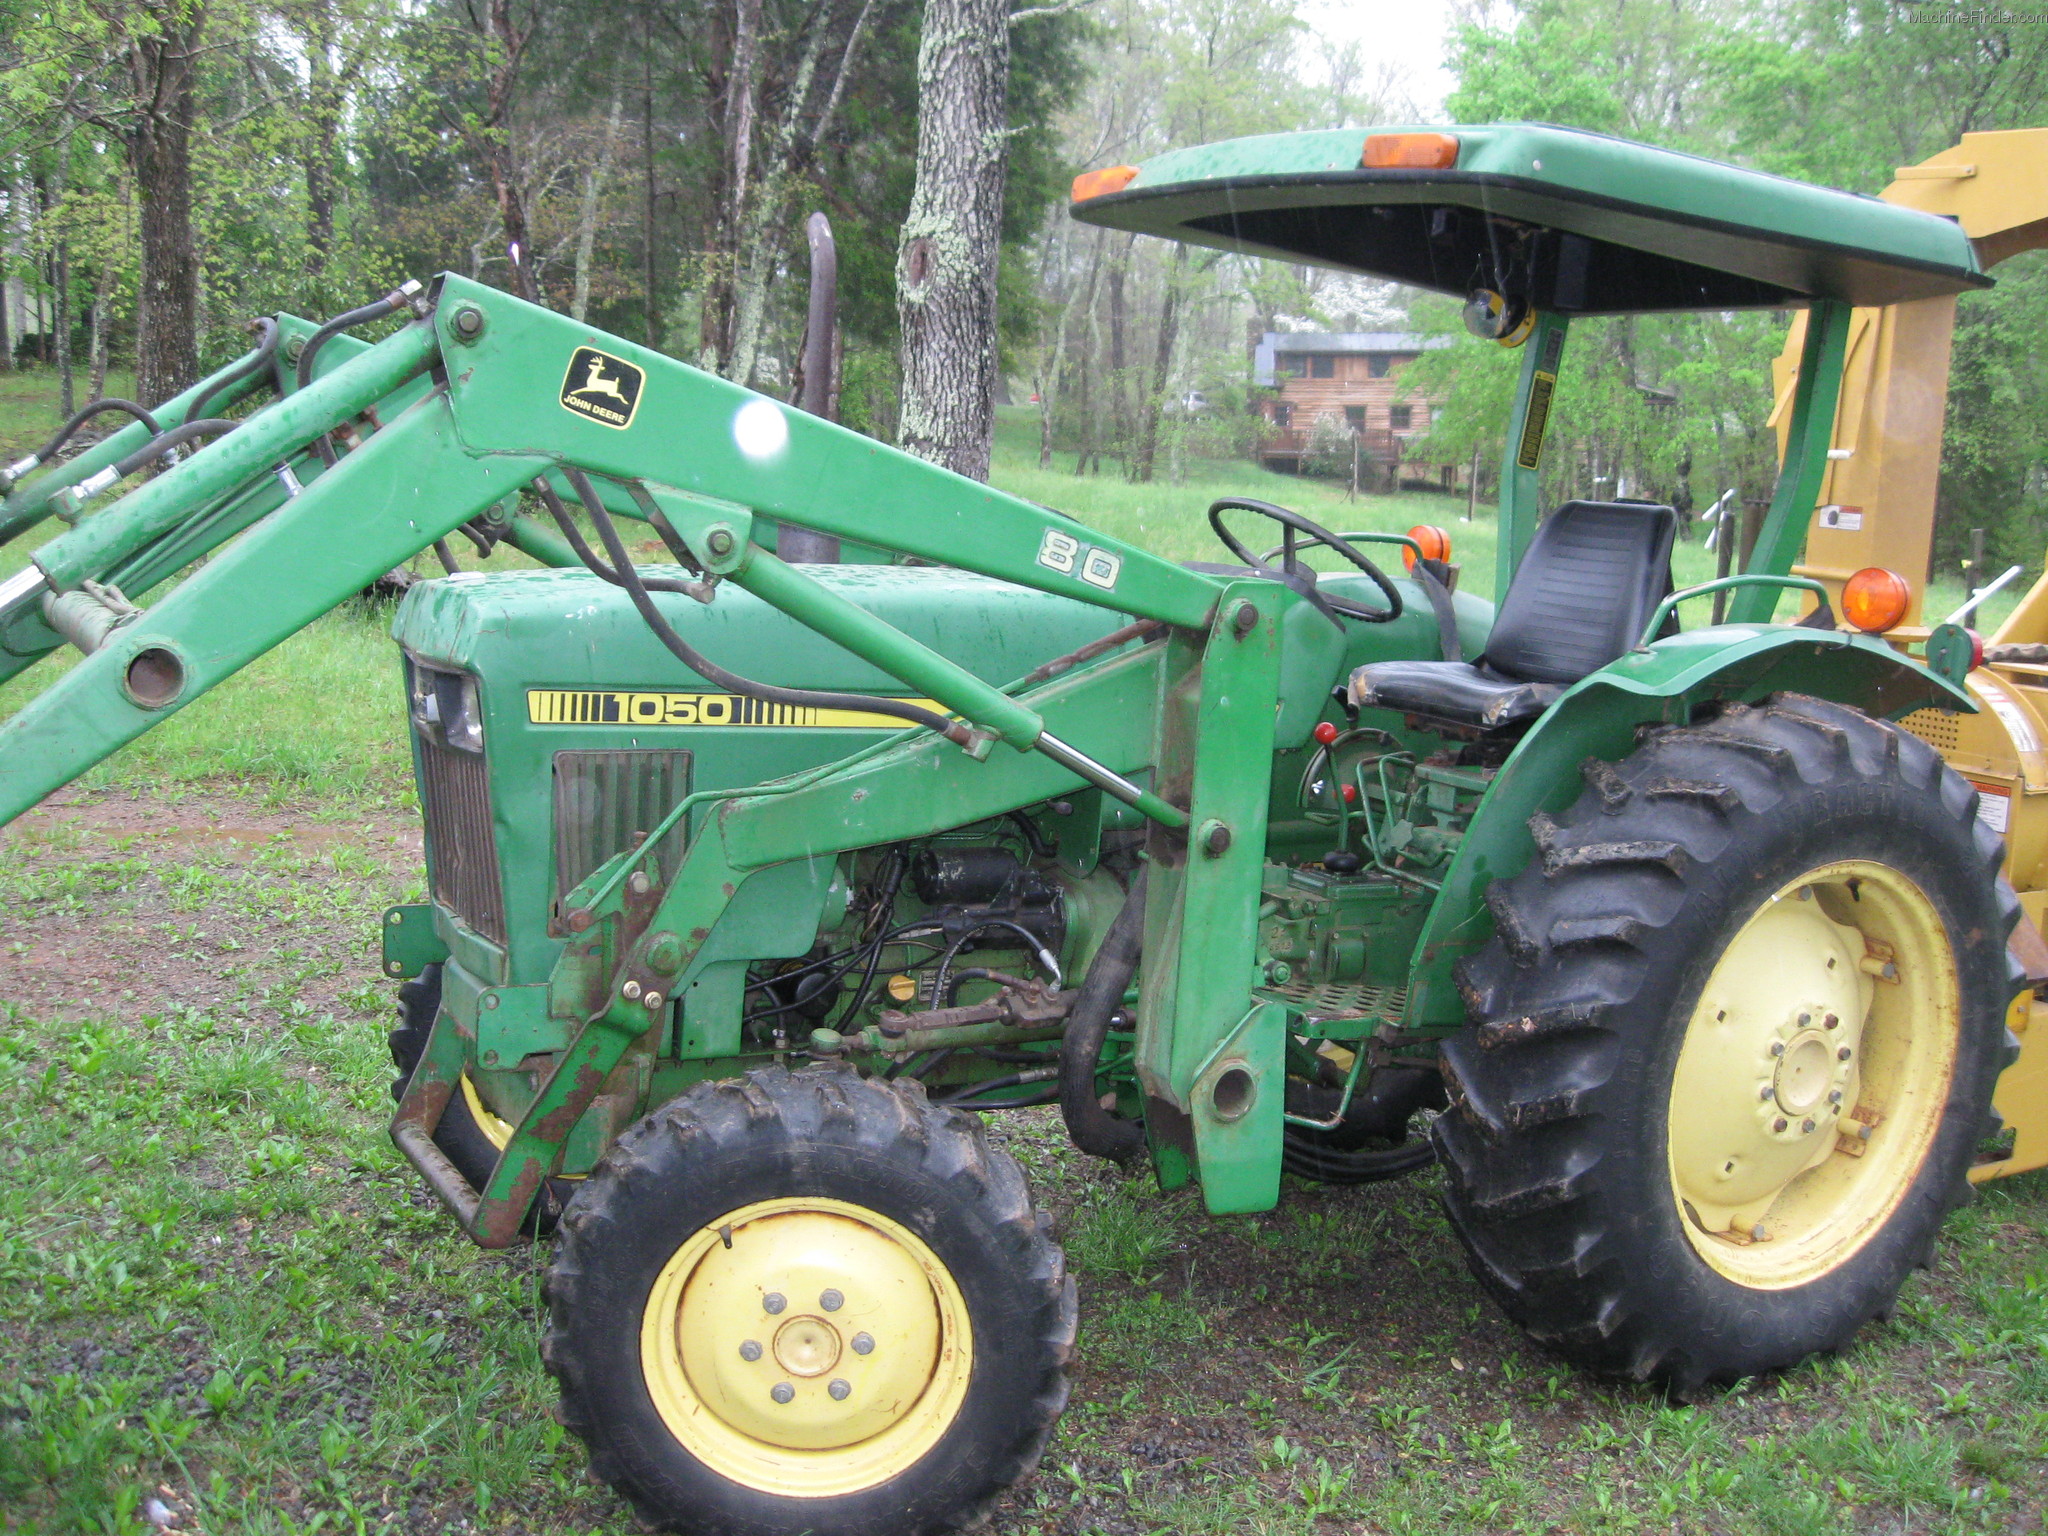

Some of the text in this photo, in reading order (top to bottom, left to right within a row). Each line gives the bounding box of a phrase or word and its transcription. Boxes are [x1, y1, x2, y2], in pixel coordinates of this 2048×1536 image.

[563, 394, 626, 424] JOHN DEERE
[1039, 529, 1122, 590] 80
[612, 695, 732, 723] 1050
